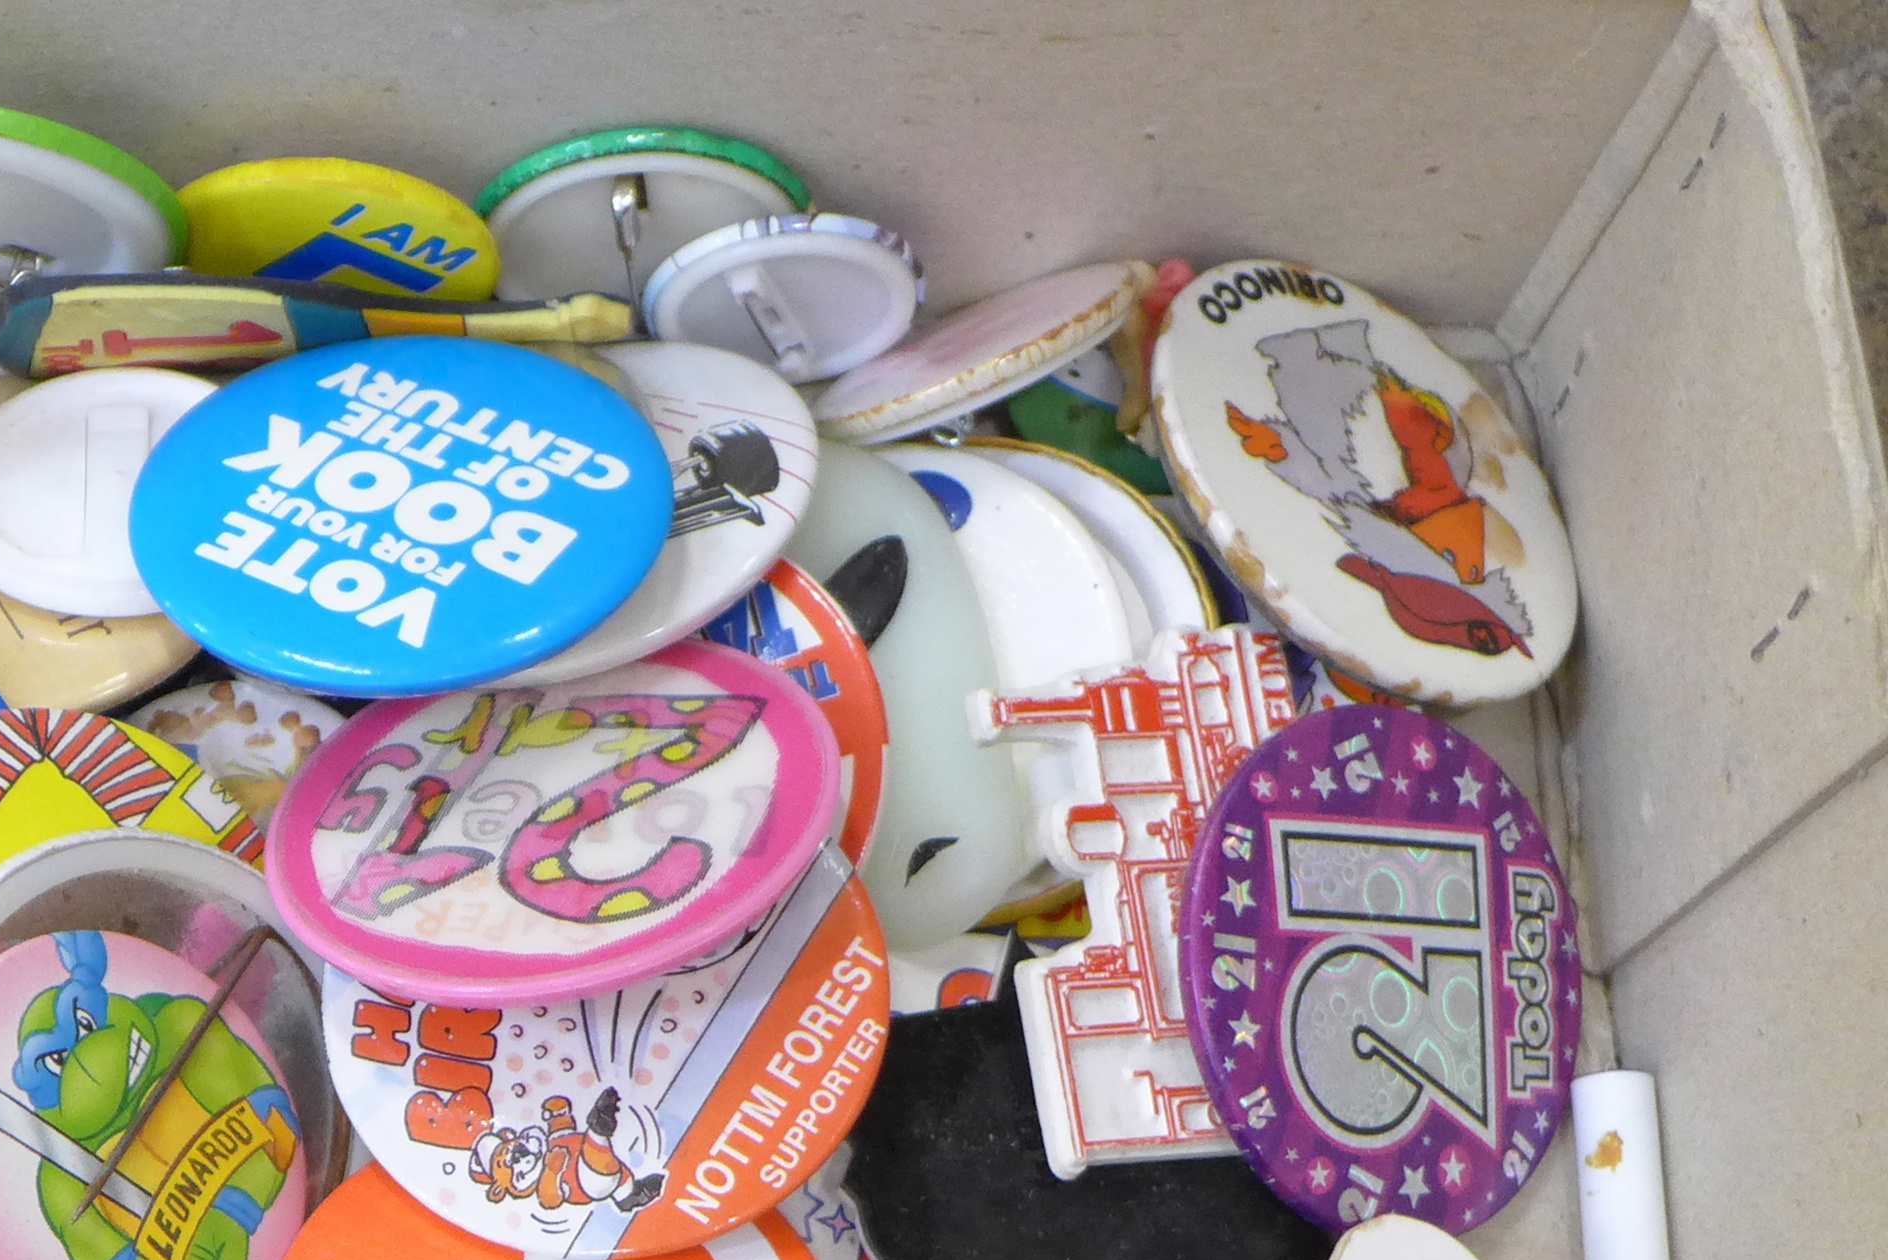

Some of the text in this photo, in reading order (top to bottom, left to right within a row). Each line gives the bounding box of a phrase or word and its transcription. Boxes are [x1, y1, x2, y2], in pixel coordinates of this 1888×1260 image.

[363, 221, 478, 272] AM
[1196, 271, 1345, 325] ORINOCO
[317, 361, 630, 491] CENTURY
[326, 400, 551, 501] OF THE
[221, 414, 579, 584] BOOK
[246, 483, 467, 587] FOR YOUR
[194, 509, 438, 649] VOTE
[766, 935, 887, 1089] FOREST
[1276, 816, 1501, 1152] 21
[759, 1017, 887, 1190] SUPPORTER
